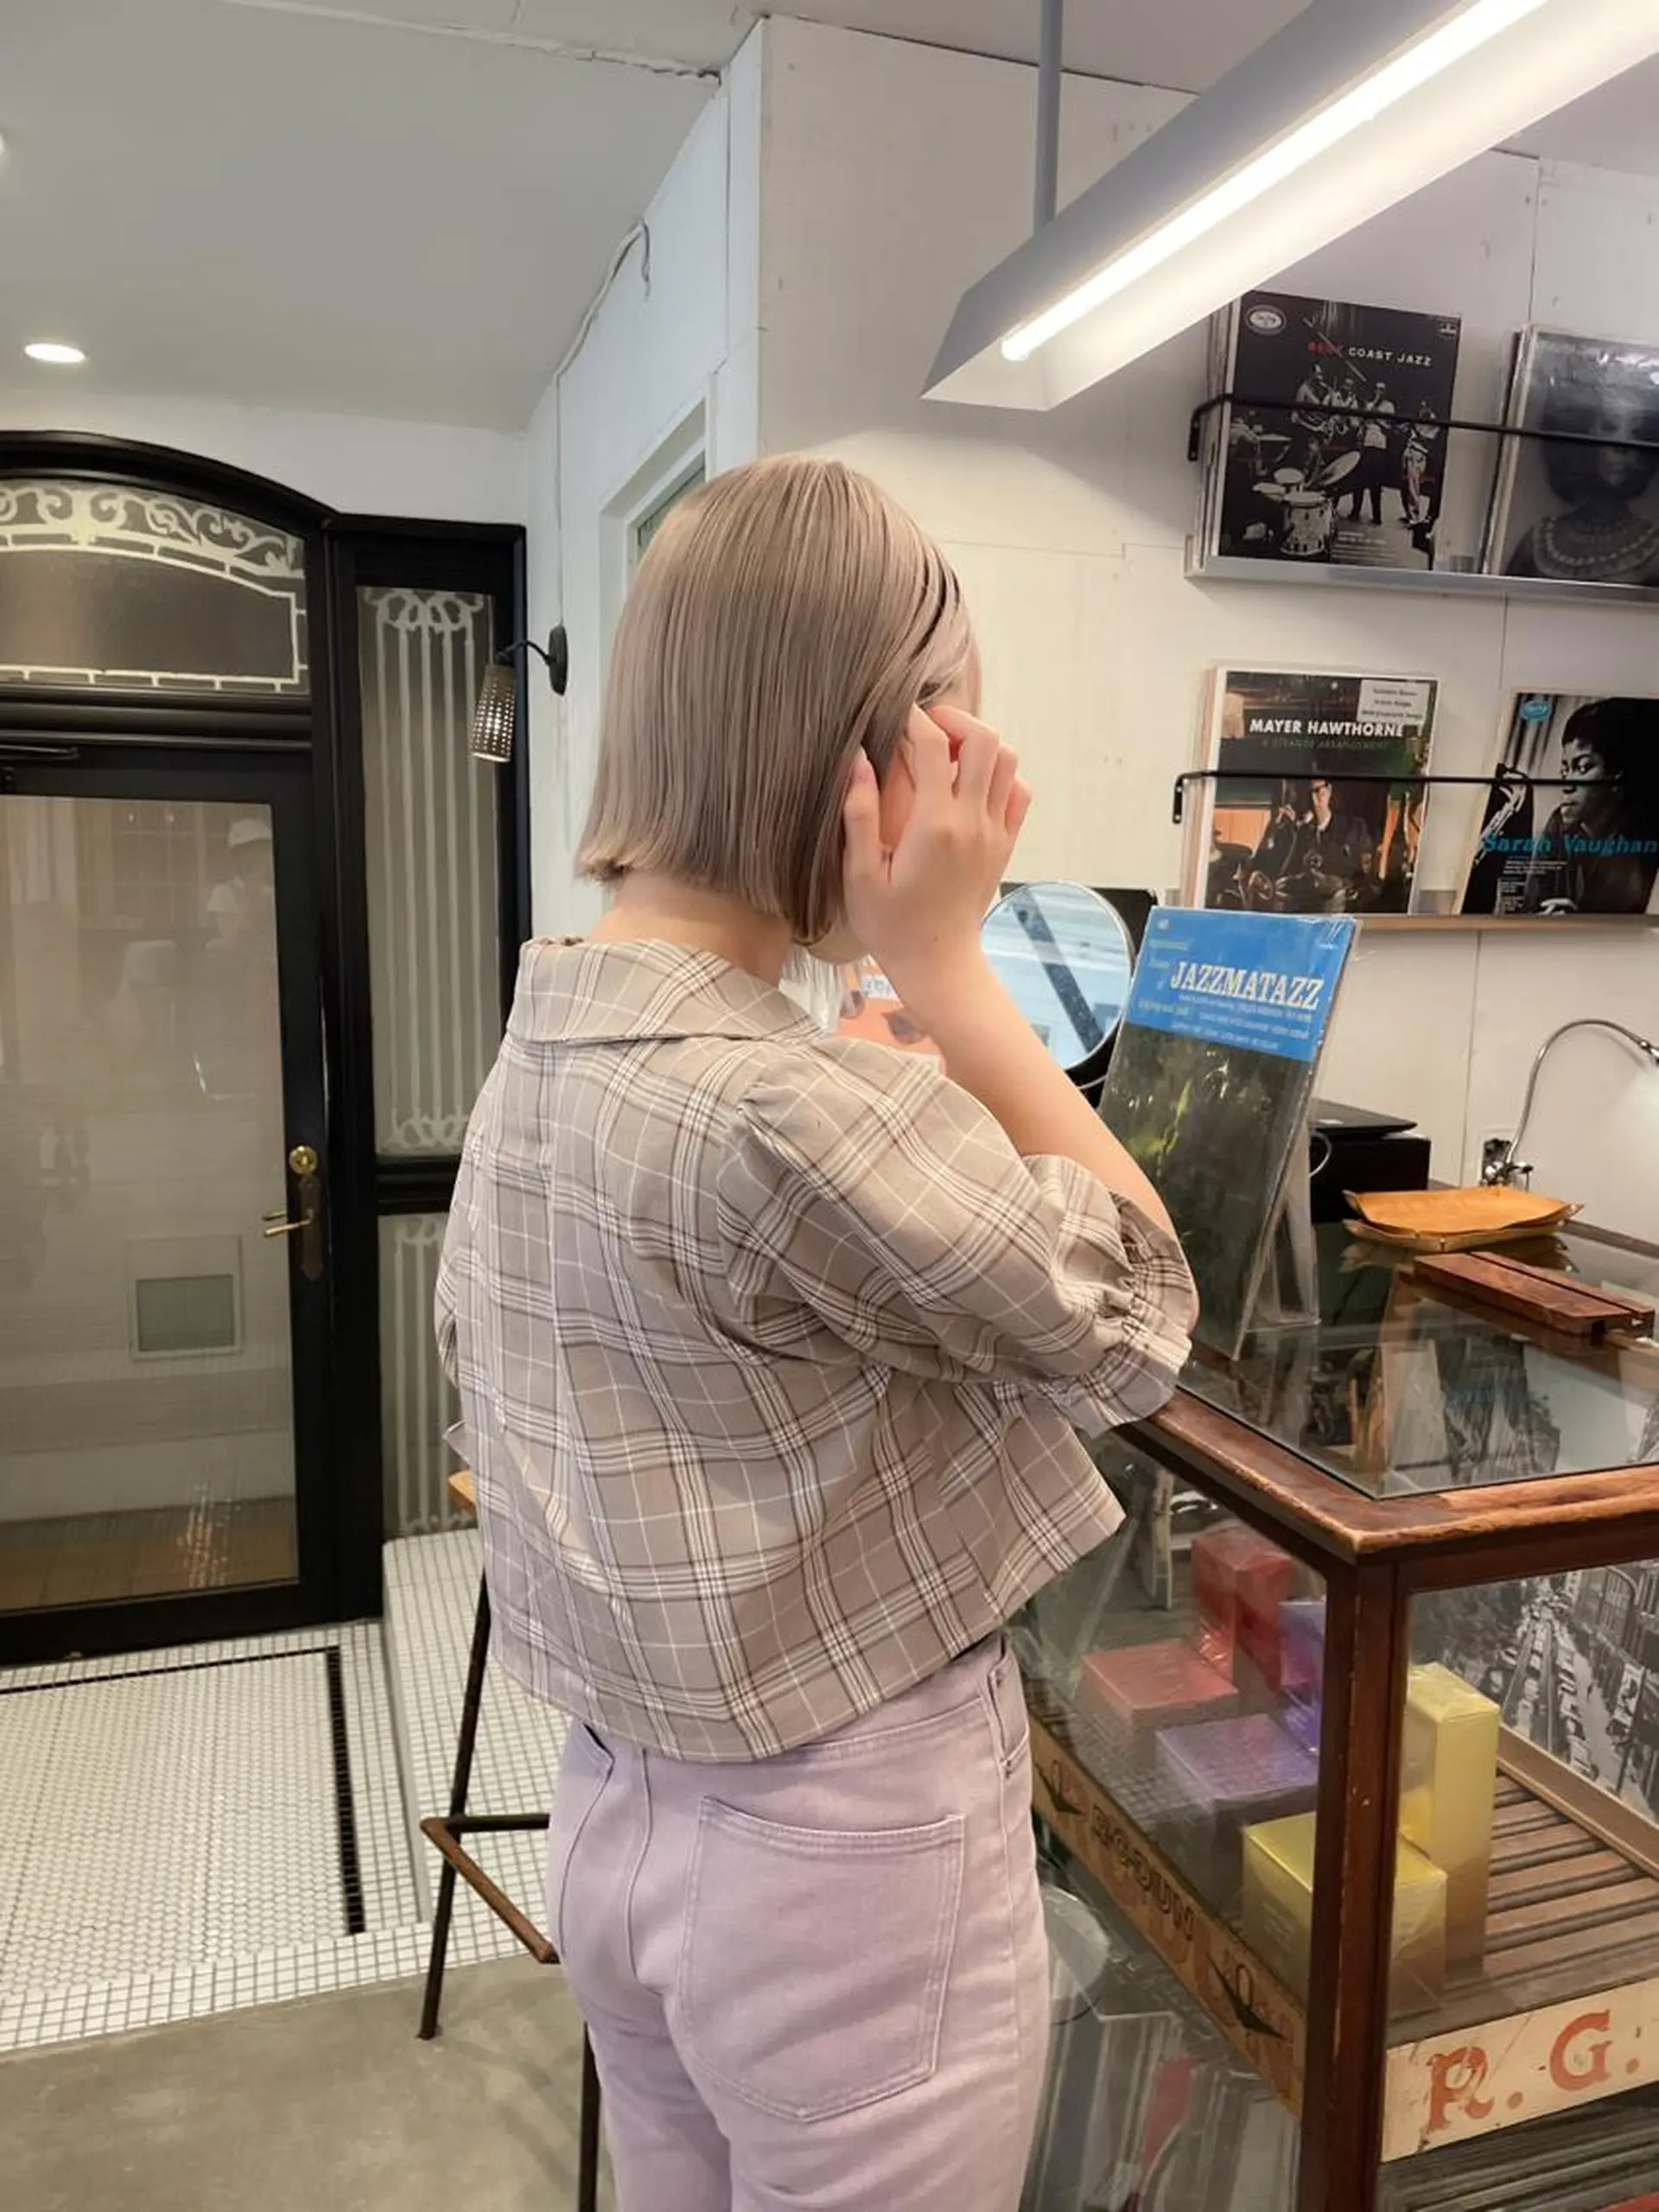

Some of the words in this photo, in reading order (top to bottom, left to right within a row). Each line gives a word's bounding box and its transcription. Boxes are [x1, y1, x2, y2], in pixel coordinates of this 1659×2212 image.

[1348, 346, 1394, 362] COAST
[1397, 353, 1433, 367] JAZZ
[1249, 718, 1302, 734] MAYER
[1306, 720, 1404, 738] HAWTHORNE
[1483, 833, 1553, 853] Sarah
[1564, 833, 1659, 857] Vaughan
[1170, 960, 1325, 1010] JAZZMATAZZ
